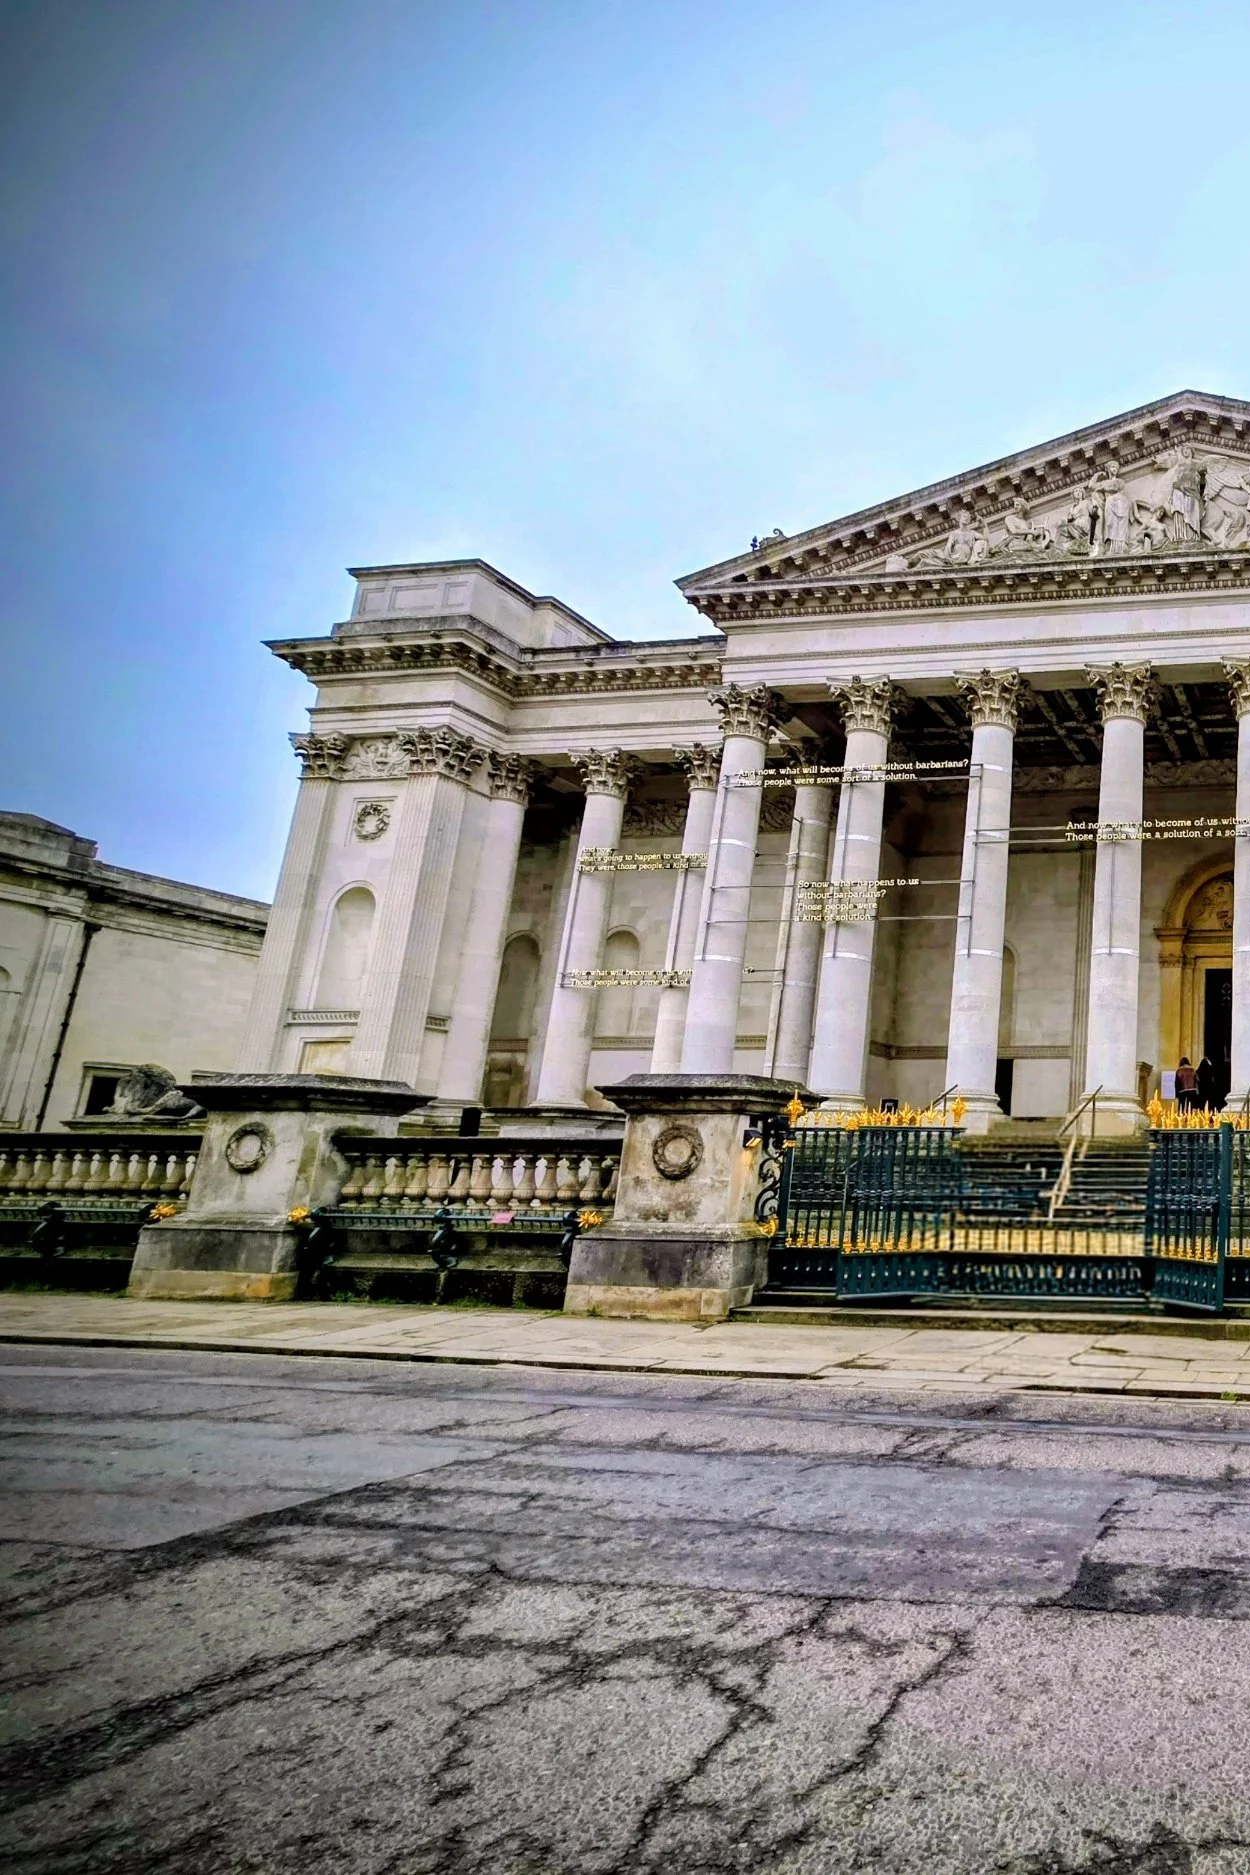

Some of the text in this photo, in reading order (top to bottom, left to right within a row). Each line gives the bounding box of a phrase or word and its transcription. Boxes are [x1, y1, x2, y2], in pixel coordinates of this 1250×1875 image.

[739, 768, 754, 776] And
[880, 762, 912, 770] without
[916, 759, 968, 769] barbarians?
[764, 778, 792, 788] people
[842, 774, 860, 782] sort
[882, 772, 918, 780] solution.
[1066, 821, 1085, 830] And
[1156, 819, 1192, 828] become
[1194, 818, 1204, 826] of
[1065, 832, 1094, 841] Those
[1096, 832, 1126, 842] people
[1163, 830, 1200, 838] solution
[1204, 828, 1214, 837] of
[602, 854, 623, 863] going
[634, 853, 661, 863] happen
[798, 880, 810, 888] So
[858, 879, 894, 888] happens
[798, 890, 886, 899] without barbarians?
[796, 902, 822, 911] Those
[824, 902, 854, 912] people
[803, 913, 822, 922] kind
[826, 913, 834, 922] of
[571, 968, 587, 976] Now
[594, 979, 618, 988] people
[662, 978, 678, 986] kind
[680, 977, 689, 986] of
